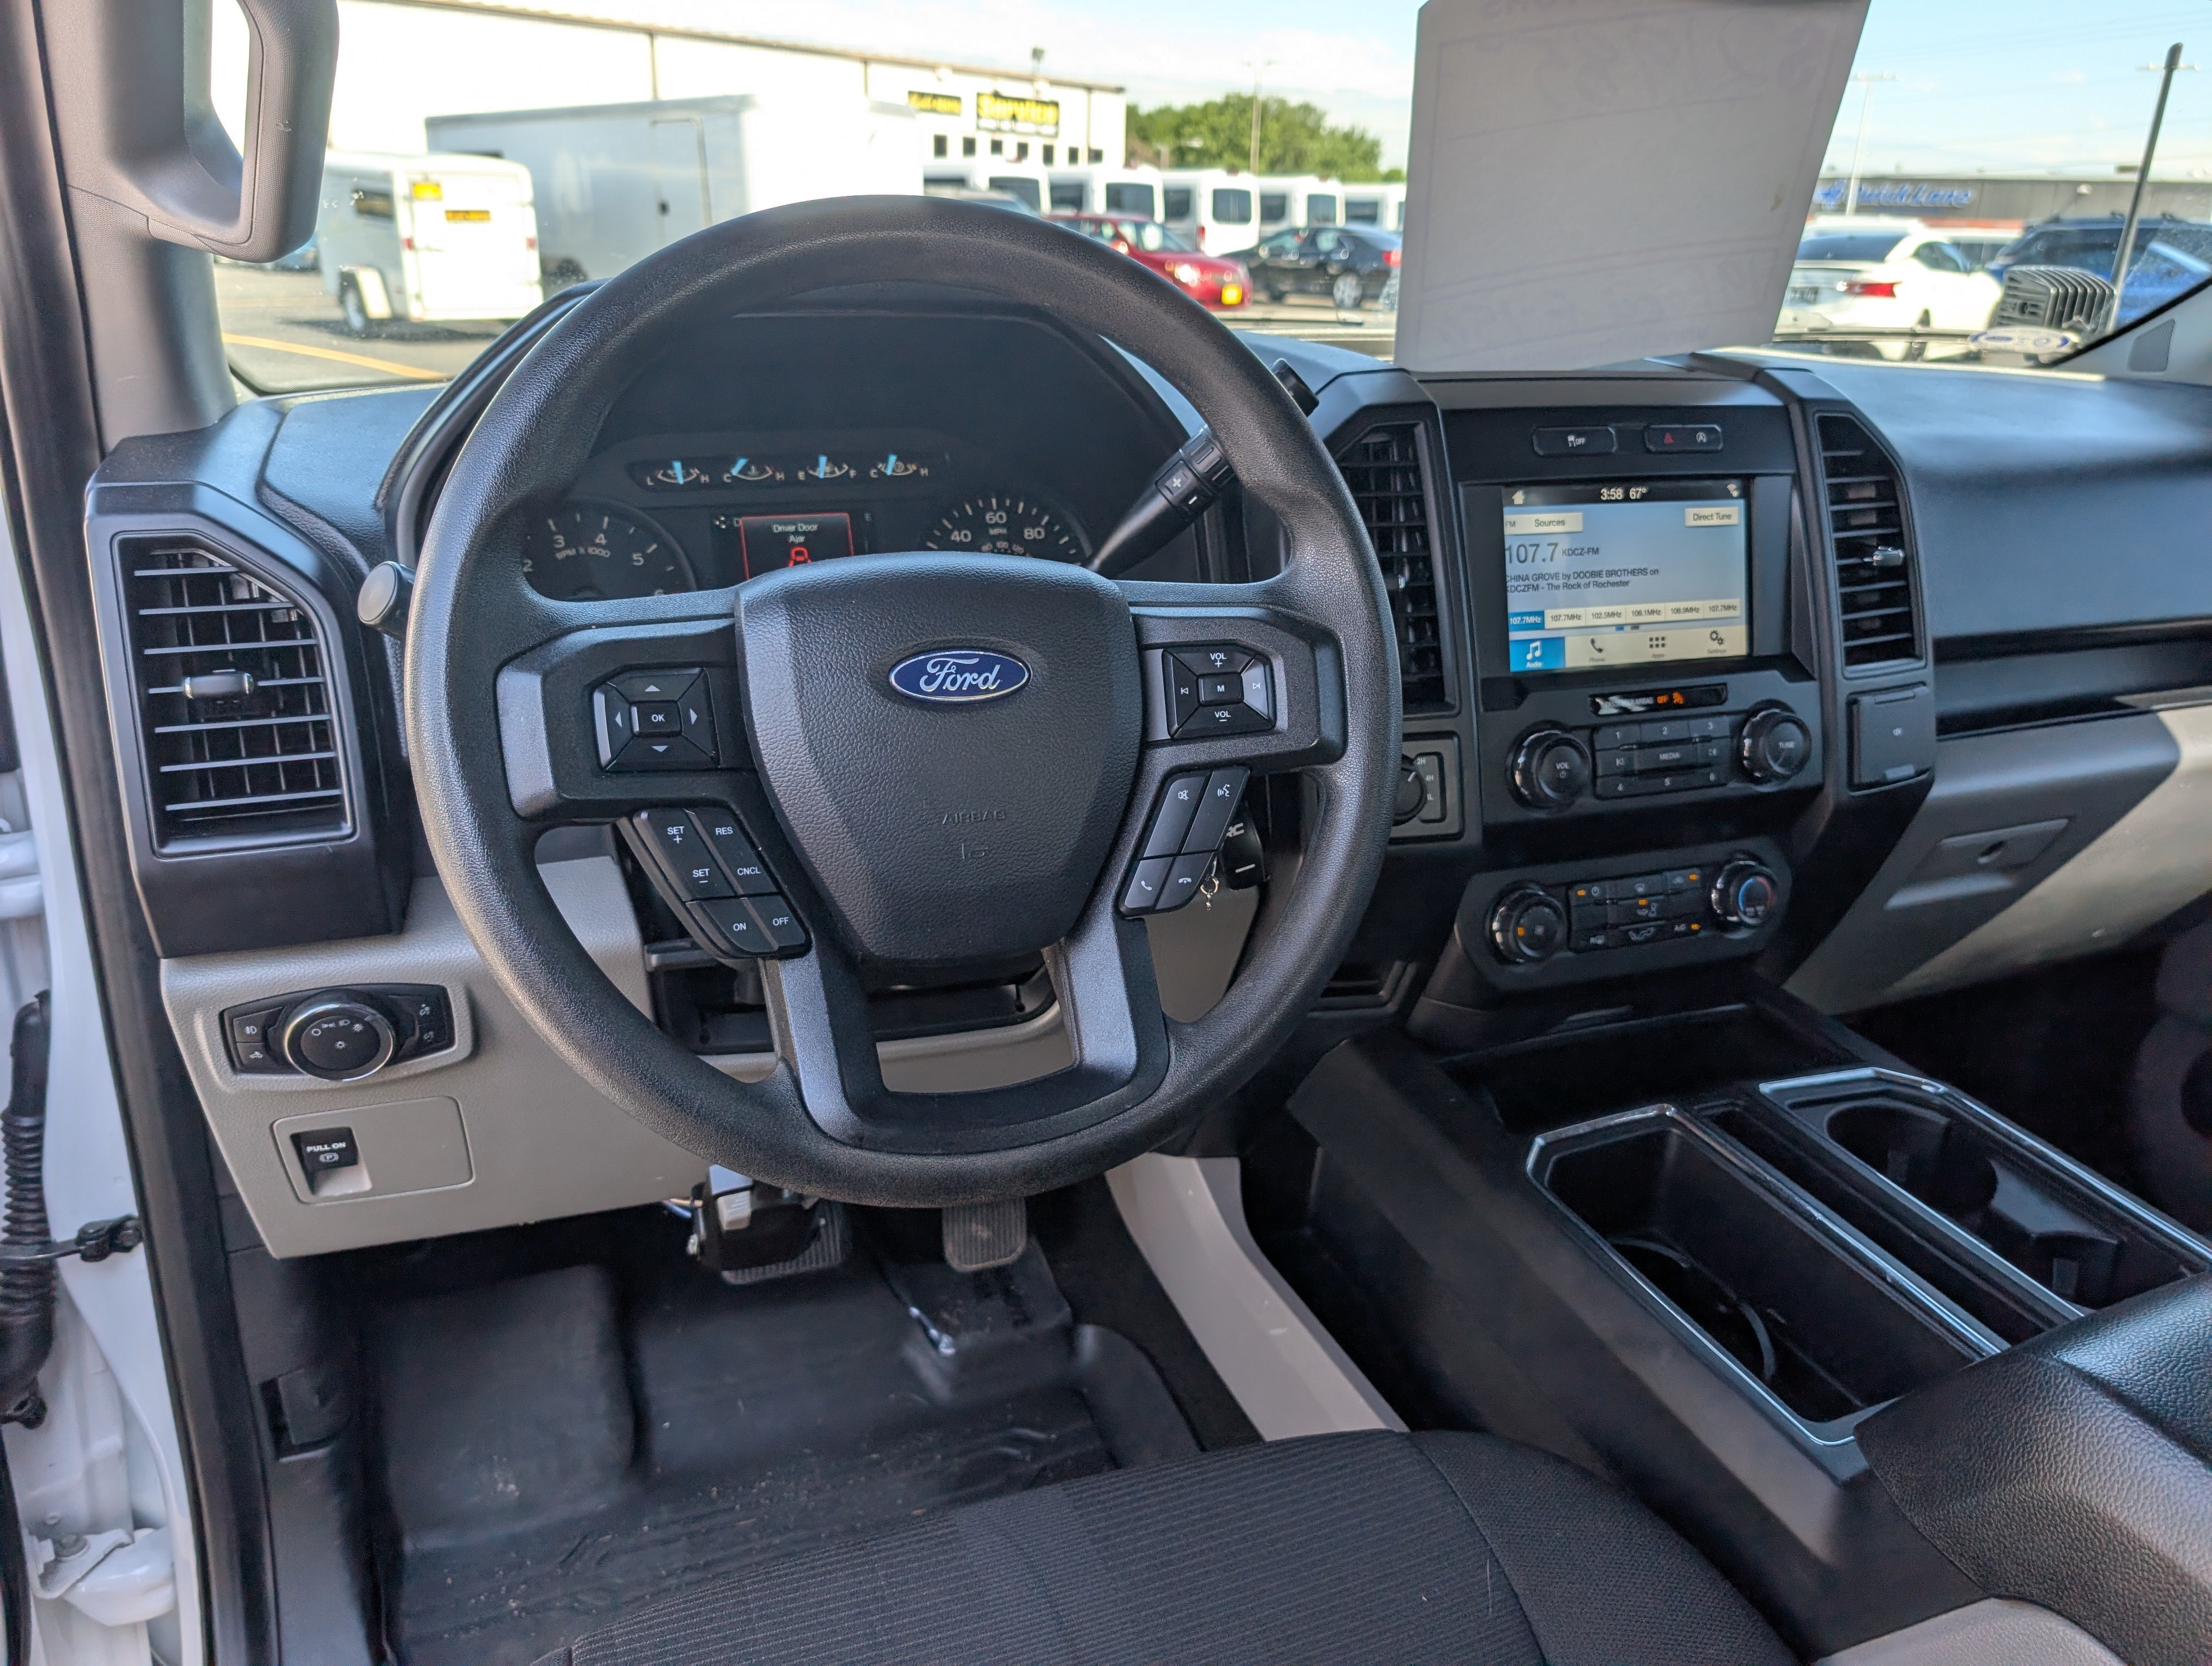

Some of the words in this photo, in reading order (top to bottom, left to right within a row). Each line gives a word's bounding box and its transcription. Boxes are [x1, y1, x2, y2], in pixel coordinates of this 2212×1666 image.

[1600, 488, 1624, 500] 3:58
[985, 511, 1007, 524] 60
[1693, 512, 1714, 521] Direct
[1715, 512, 1732, 521] Tune
[798, 522, 818, 532] Door
[1534, 519, 1566, 528] Sources
[950, 529, 972, 543] 40
[1024, 527, 1045, 540] 80
[553, 535, 565, 548] 3
[595, 533, 608, 546] 4
[1505, 542, 1559, 564] 107.7
[1562, 547, 1599, 556] KDCZ-FM
[633, 553, 645, 566] 5
[523, 559, 533, 572] 2
[1531, 572, 1560, 582] GROVE
[1561, 572, 1571, 582] by
[1573, 570, 1604, 580] DOOBIE
[1605, 568, 1648, 578] BROTHERS
[1546, 583, 1560, 591] The
[1562, 581, 1581, 590] Rock
[1583, 581, 1591, 589] of
[1592, 580, 1630, 589] Rochester
[1210, 652, 1227, 661] VOL
[919, 657, 1001, 693] Ford
[651, 714, 665, 722] OK
[1214, 710, 1231, 719] VOL
[667, 825, 684, 834] SET
[715, 825, 733, 836] RES
[692, 868, 710, 877] SET
[737, 866, 761, 876] CNCL
[773, 916, 789, 926] OFF
[732, 922, 747, 932] ON
[306, 1144, 331, 1153] PULL
[332, 1142, 346, 1150] ON
